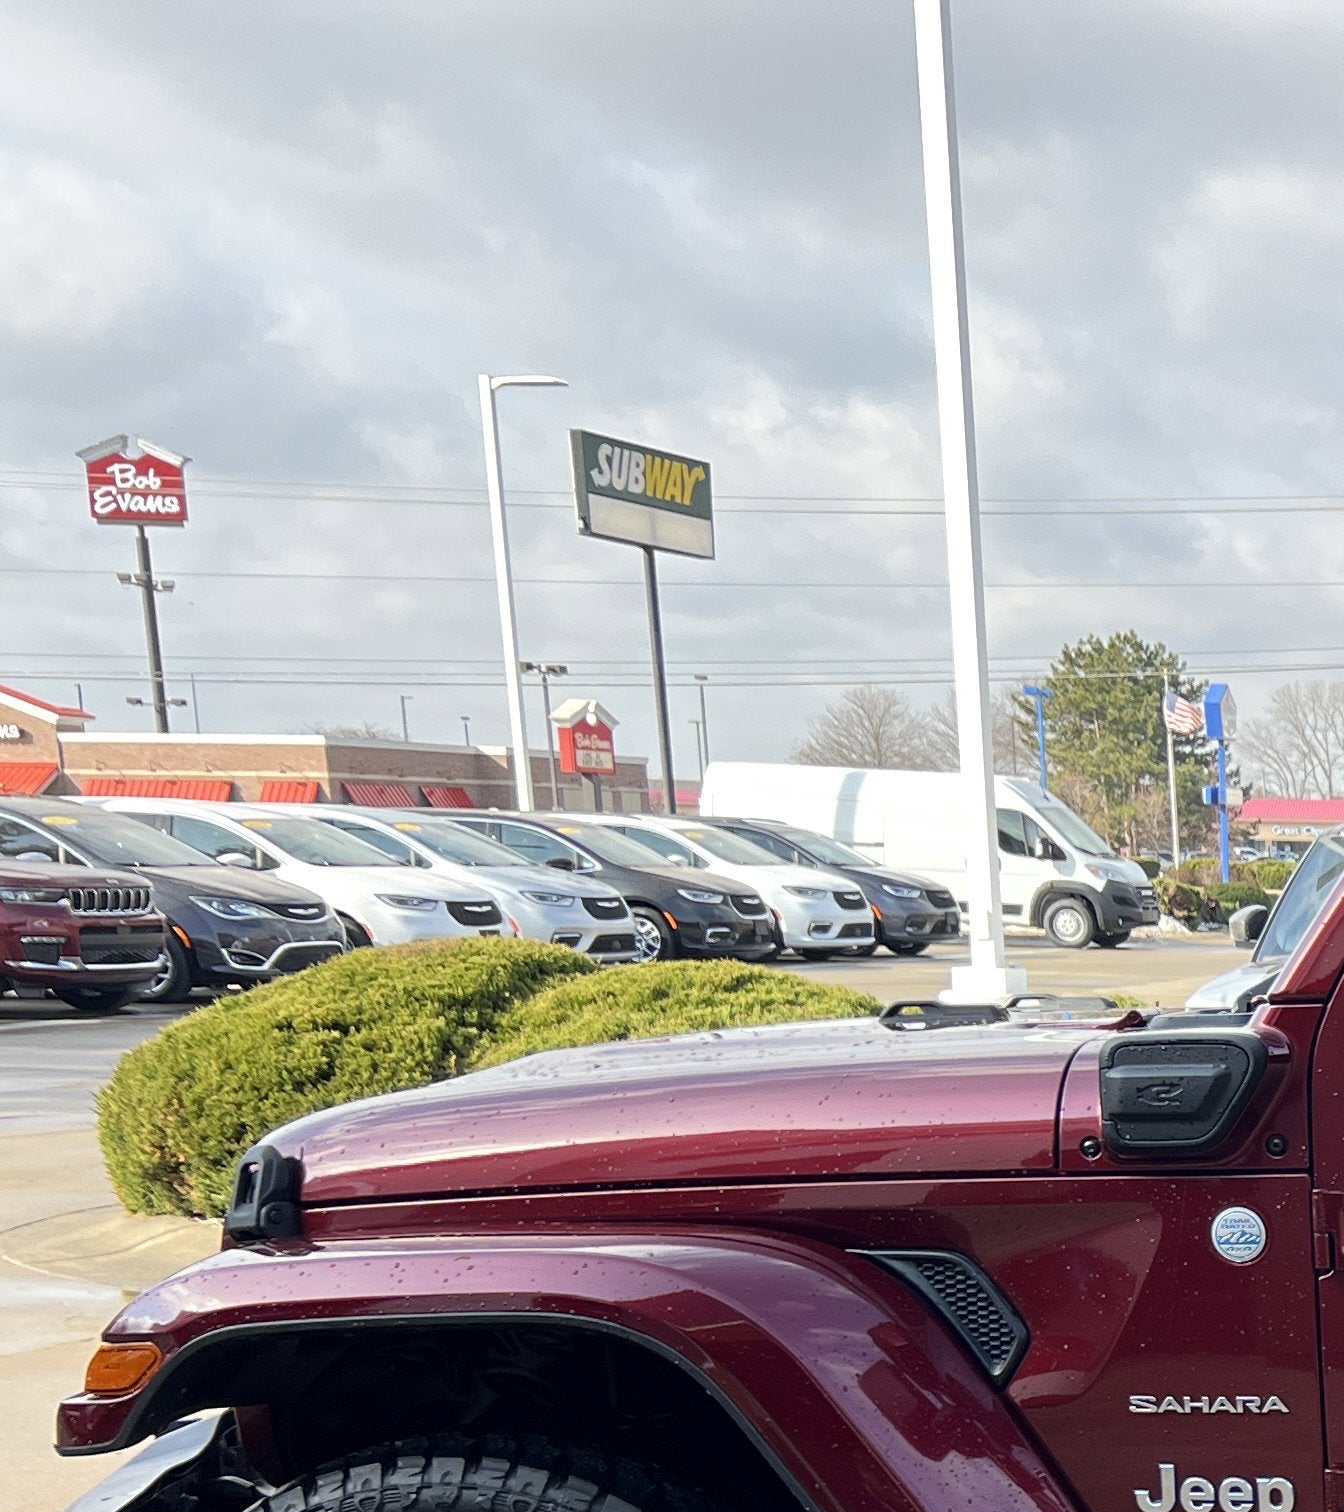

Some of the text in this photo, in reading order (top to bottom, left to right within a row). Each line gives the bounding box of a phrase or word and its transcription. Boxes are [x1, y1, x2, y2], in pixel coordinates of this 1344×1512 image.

[106, 463, 160, 489] Bob
[590, 443, 705, 506] SUBWAY
[93, 485, 180, 514] Evans
[1129, 1395, 1290, 1413] SAHARA
